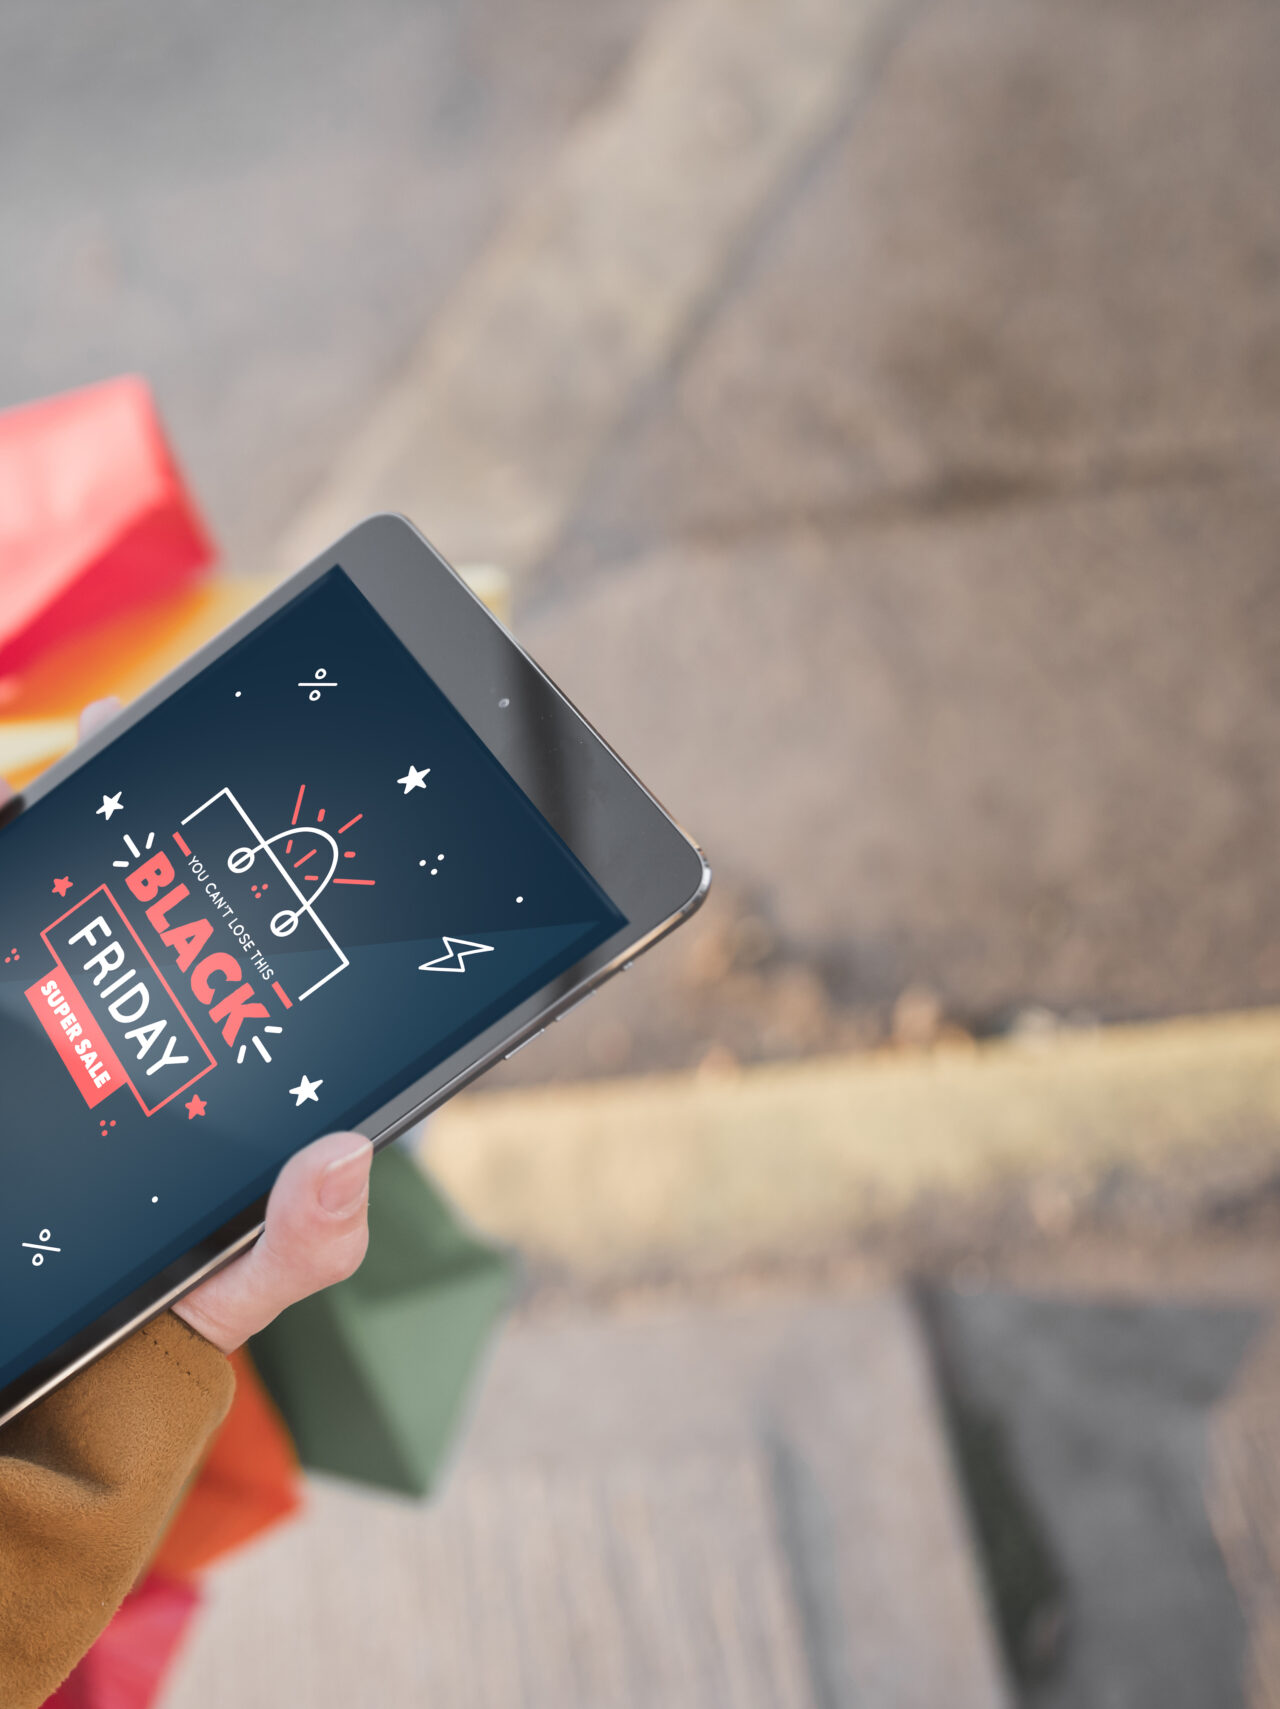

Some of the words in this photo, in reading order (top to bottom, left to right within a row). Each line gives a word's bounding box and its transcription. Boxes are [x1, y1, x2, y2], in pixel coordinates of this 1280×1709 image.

[124, 850, 271, 1048] BLACK
[187, 855, 210, 882] YOU
[205, 882, 235, 918] CAN'T
[227, 917, 256, 952] LOSE
[250, 949, 275, 981] THIS
[40, 979, 83, 1043] SUPER
[74, 1038, 111, 1089] SALE
[68, 915, 190, 1076] FRIDAY
